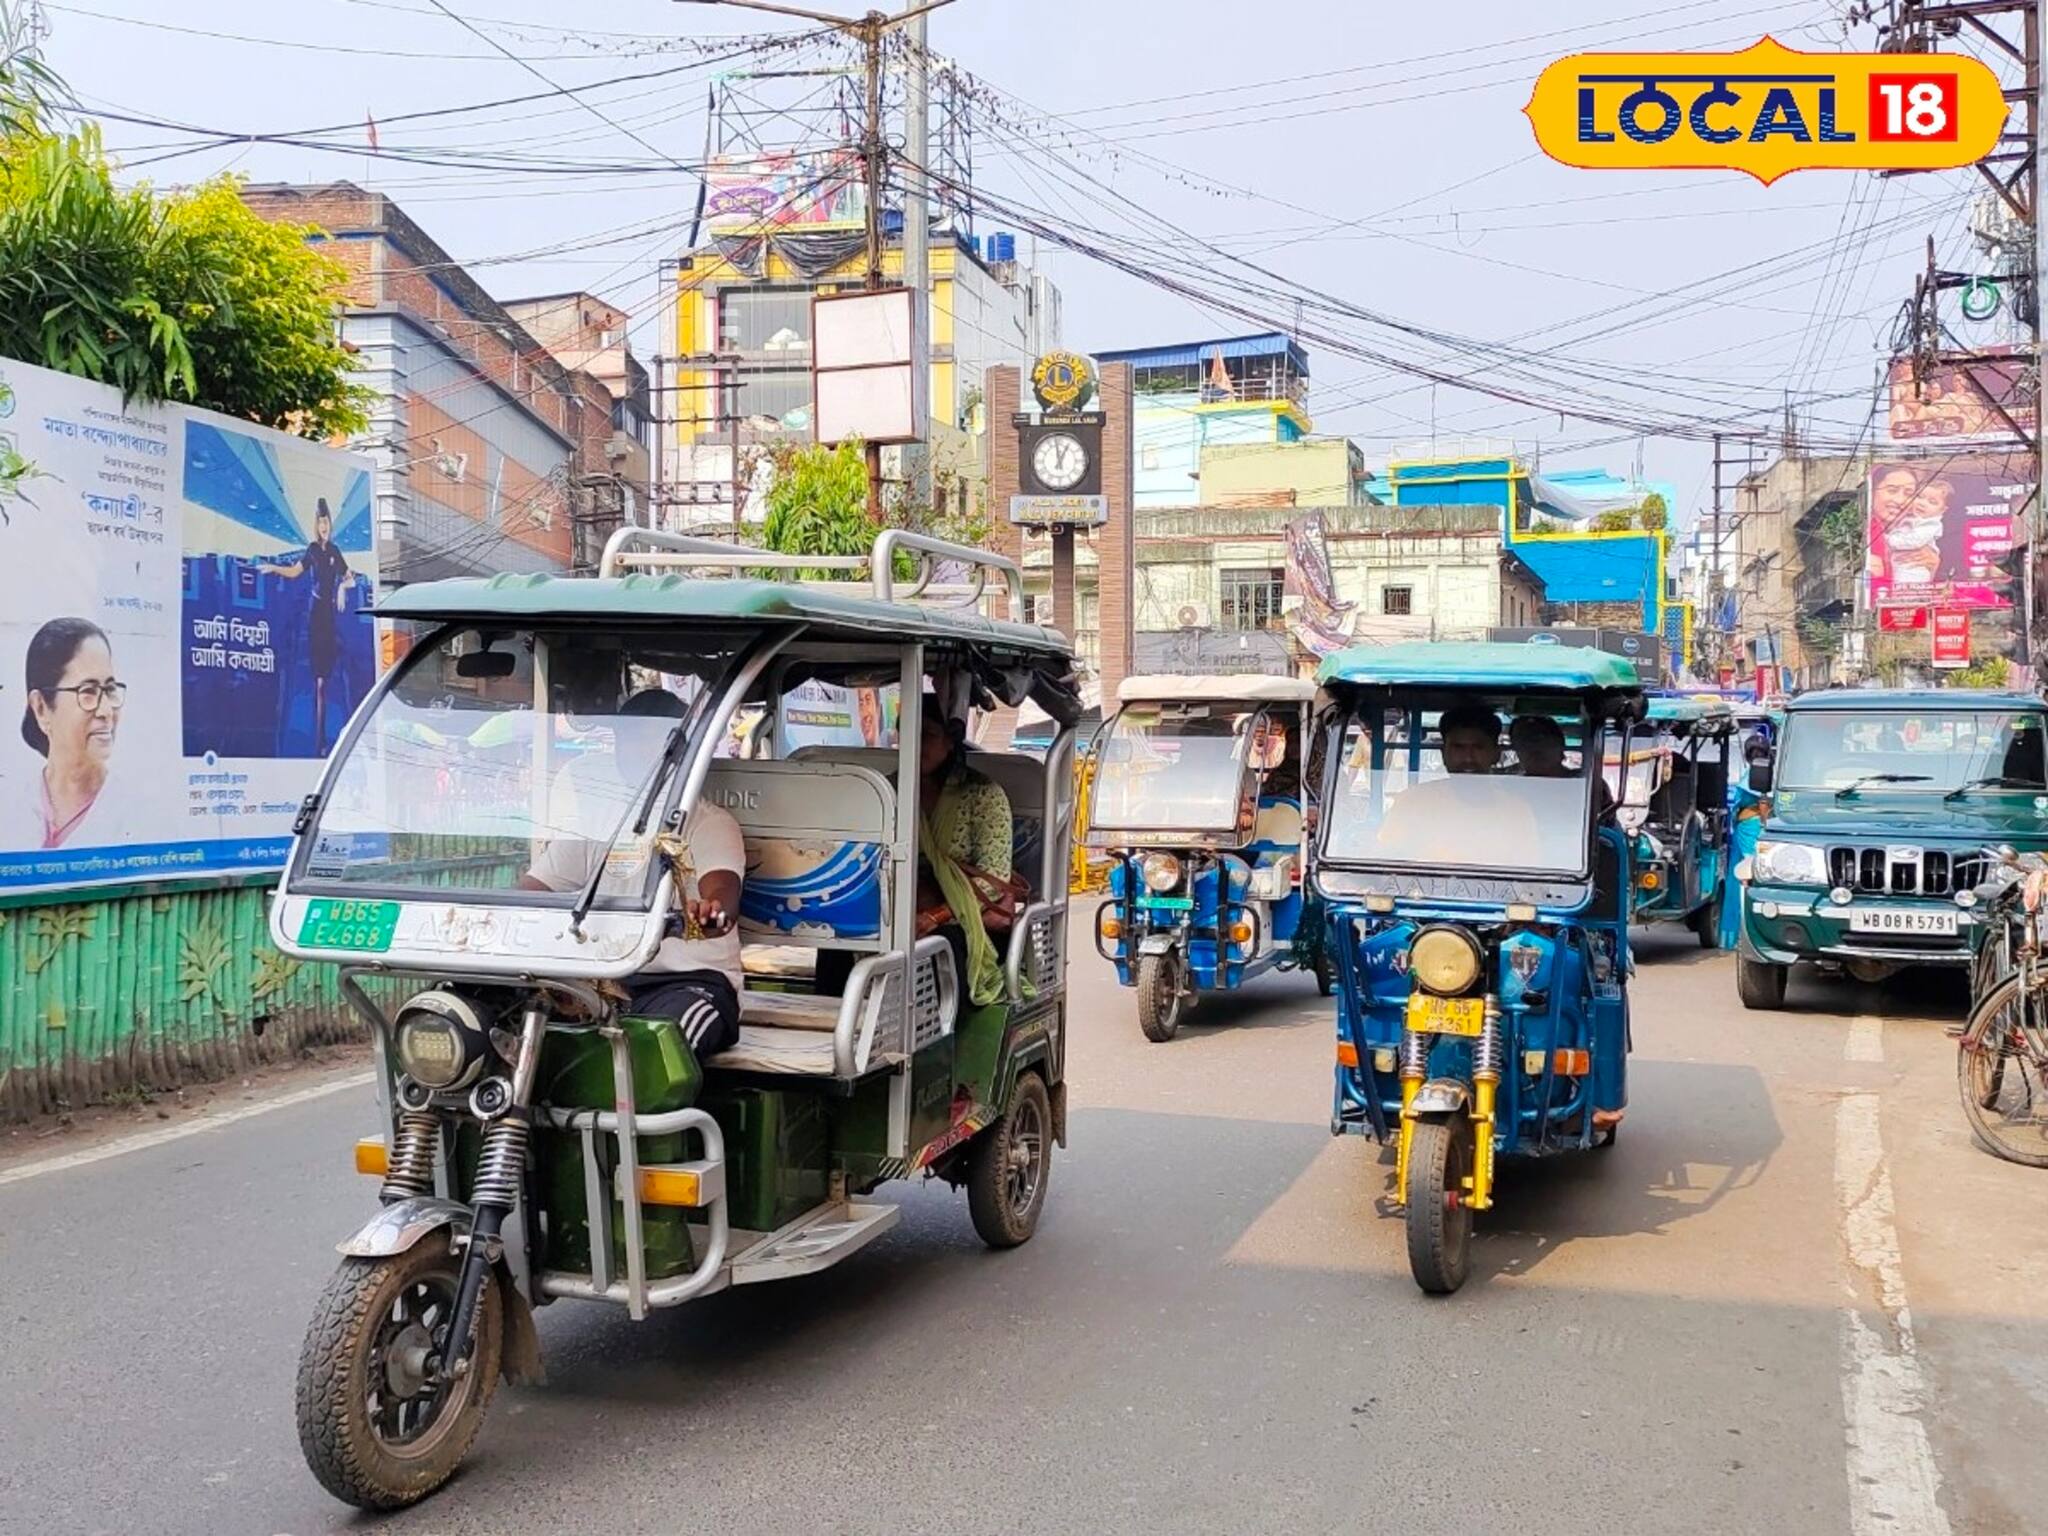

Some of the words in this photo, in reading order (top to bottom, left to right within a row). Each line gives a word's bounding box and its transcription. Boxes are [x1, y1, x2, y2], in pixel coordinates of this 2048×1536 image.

[43, 416, 79, 439] মমতা
[81, 425, 168, 457] বন্দ্যোপাধ্যায়ের
[193, 615, 228, 641] আমি
[229, 617, 270, 648] বিশ্বশ্রী
[190, 642, 227, 668] আমি
[227, 647, 275, 673] কন্যাশ্রী
[1383, 874, 1523, 902] AAHANA
[329, 901, 381, 922] WB65
[1863, 912, 1880, 928] WB
[1883, 913, 1902, 929] 08
[1905, 914, 1914, 929] R
[1917, 915, 1954, 931] 5791
[313, 921, 381, 947] E4668
